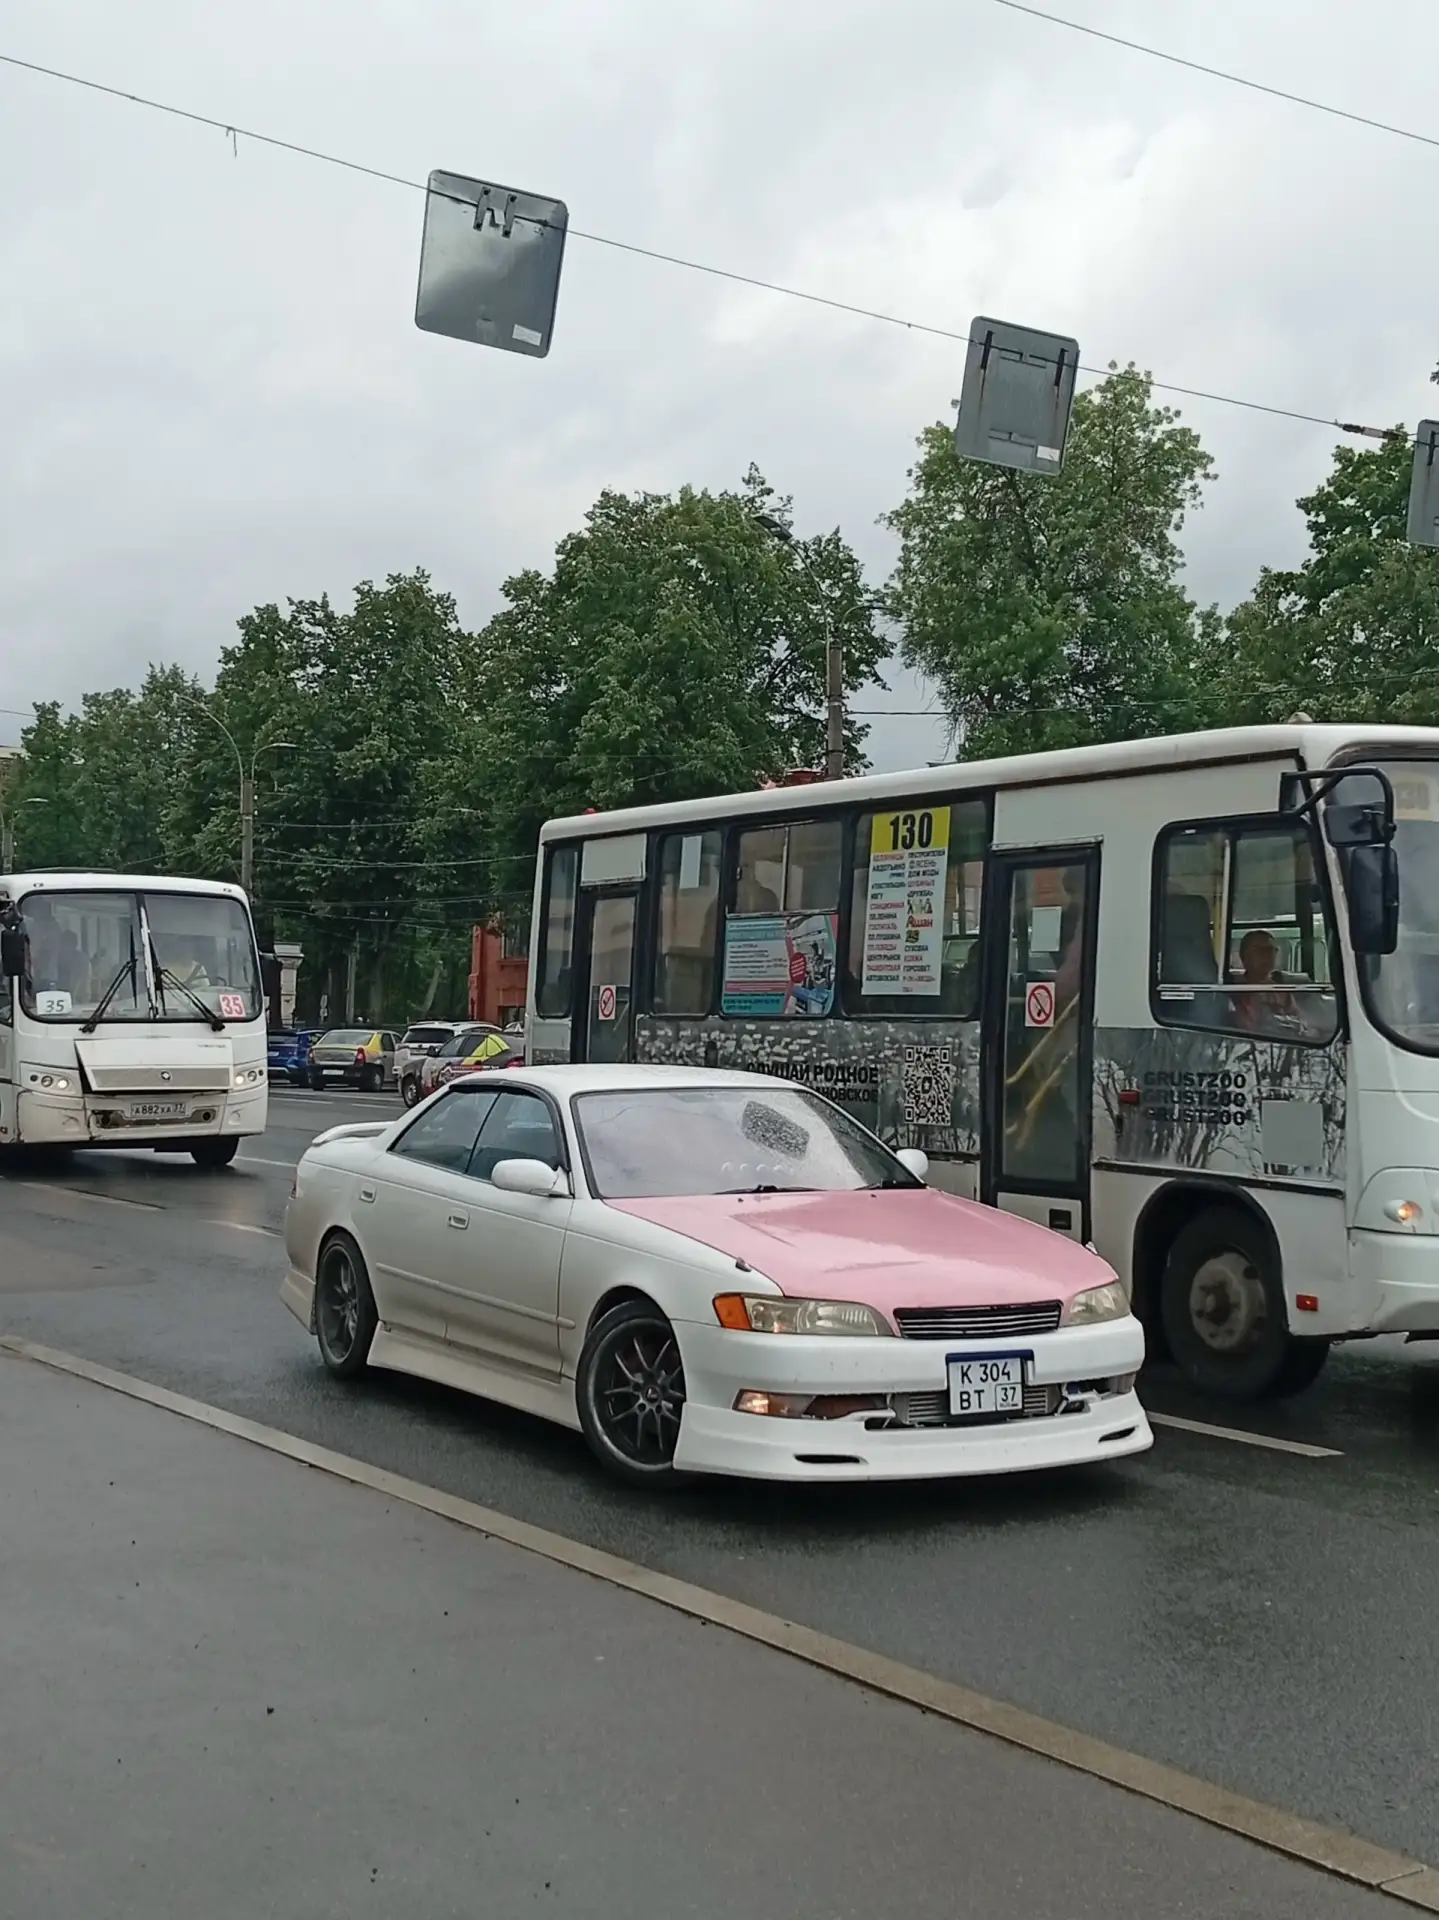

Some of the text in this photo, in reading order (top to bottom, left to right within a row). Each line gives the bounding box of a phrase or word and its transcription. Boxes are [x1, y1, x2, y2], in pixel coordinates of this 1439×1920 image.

[890, 812, 932, 850] 130
[45, 999, 65, 1013] 35
[221, 995, 244, 1016] 35
[813, 1065, 879, 1085] РОДНОЕ
[1143, 1071, 1247, 1089] GRUST200
[960, 1361, 1011, 1385] К 304
[960, 1386, 1018, 1411] ВТ 37
